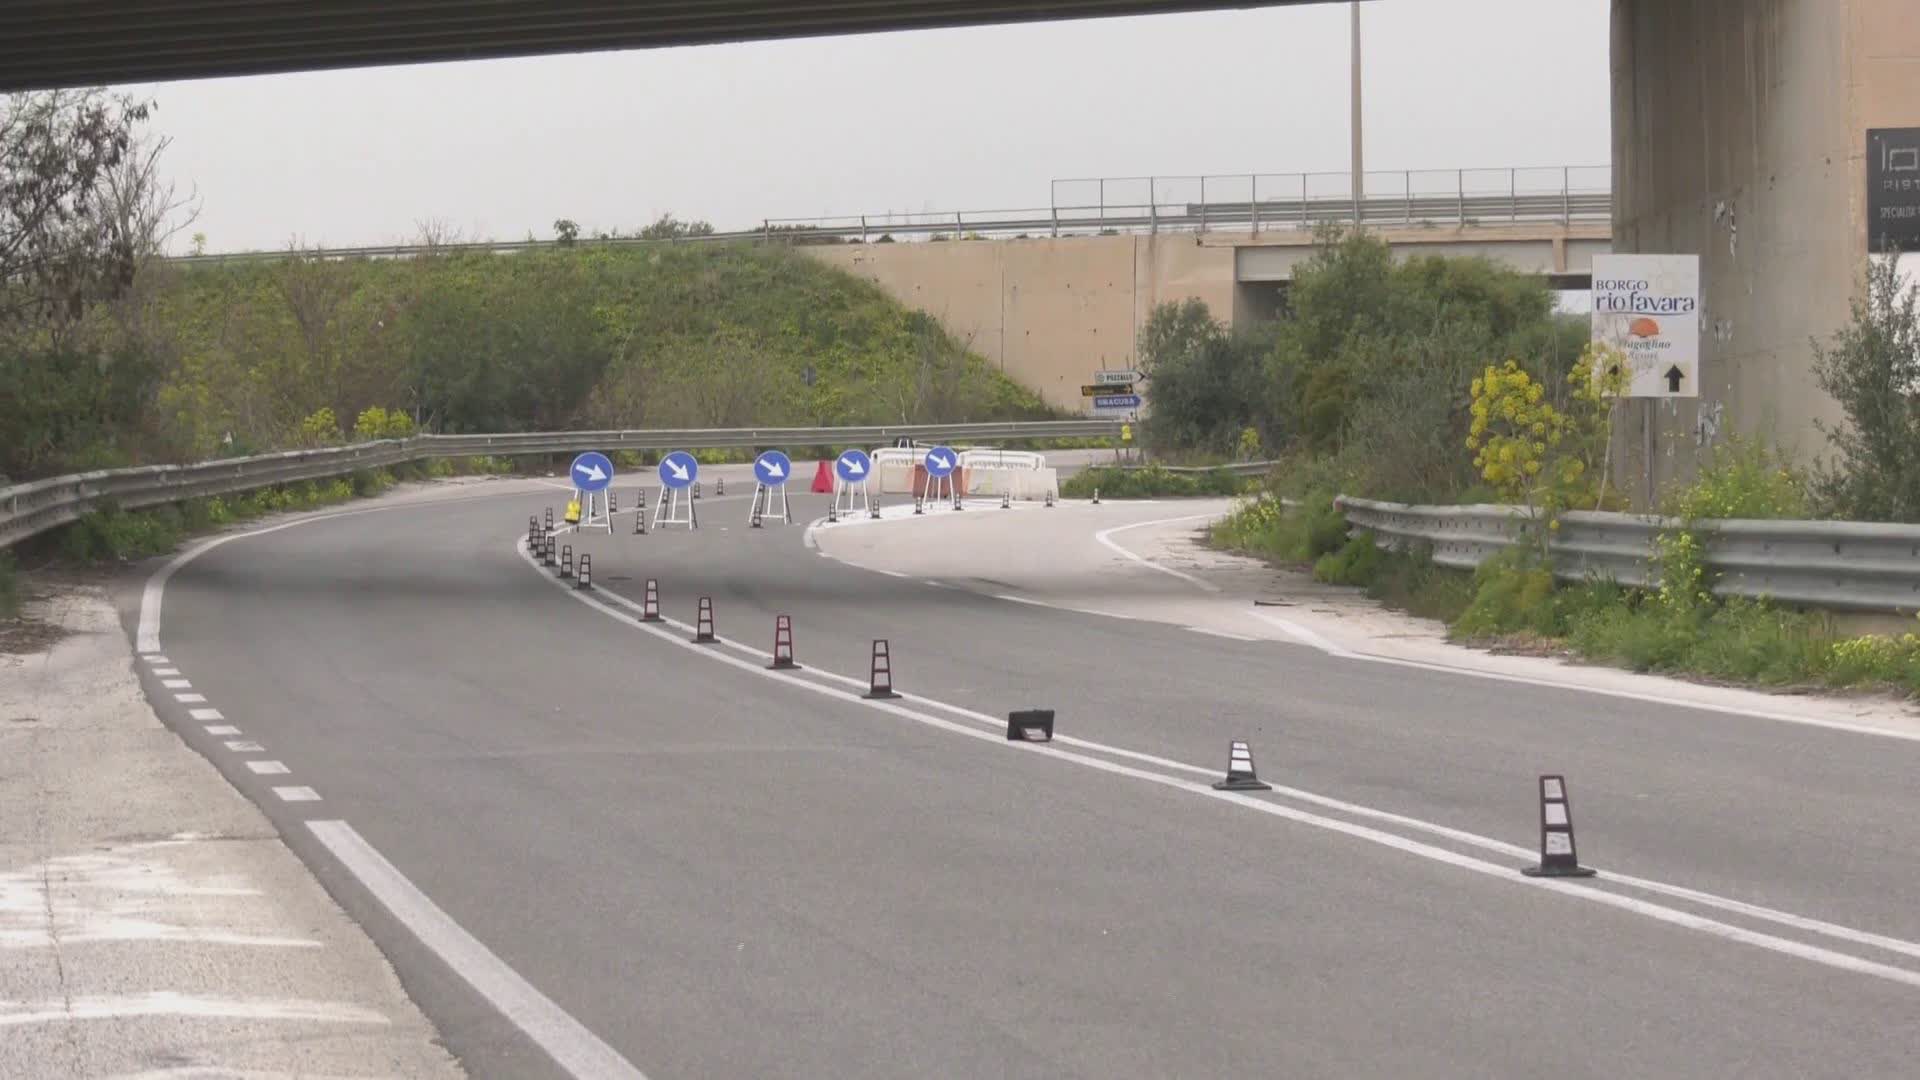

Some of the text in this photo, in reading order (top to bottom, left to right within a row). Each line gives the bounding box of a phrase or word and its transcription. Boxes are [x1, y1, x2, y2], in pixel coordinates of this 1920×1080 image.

[1596, 280, 1649, 291] BORGO
[1596, 291, 1695, 312] rio favara
[1106, 374, 1133, 382] POZZALLO
[1097, 398, 1135, 406] SIRACUSA
